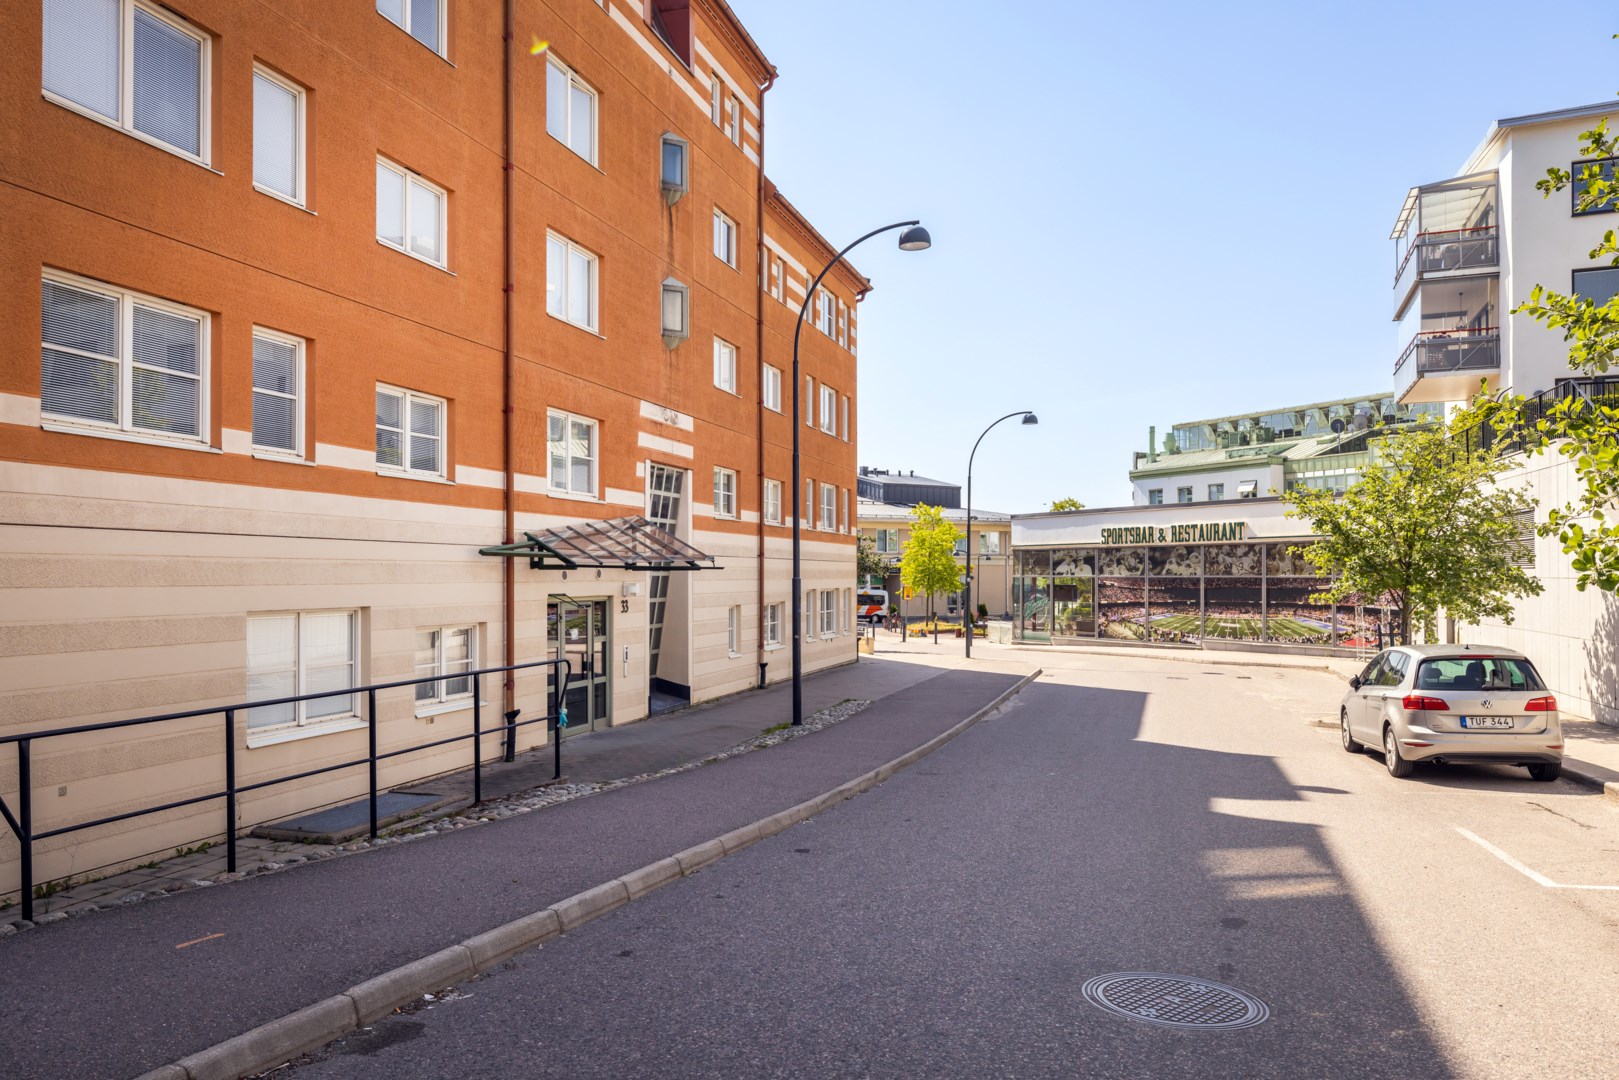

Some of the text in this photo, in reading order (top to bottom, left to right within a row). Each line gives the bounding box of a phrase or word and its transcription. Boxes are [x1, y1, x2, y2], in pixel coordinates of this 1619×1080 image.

[1101, 521, 1245, 545] SPORTSBAR & RESTAURANT
[621, 599, 629, 613] 33
[1469, 717, 1509, 726] TUF 344
